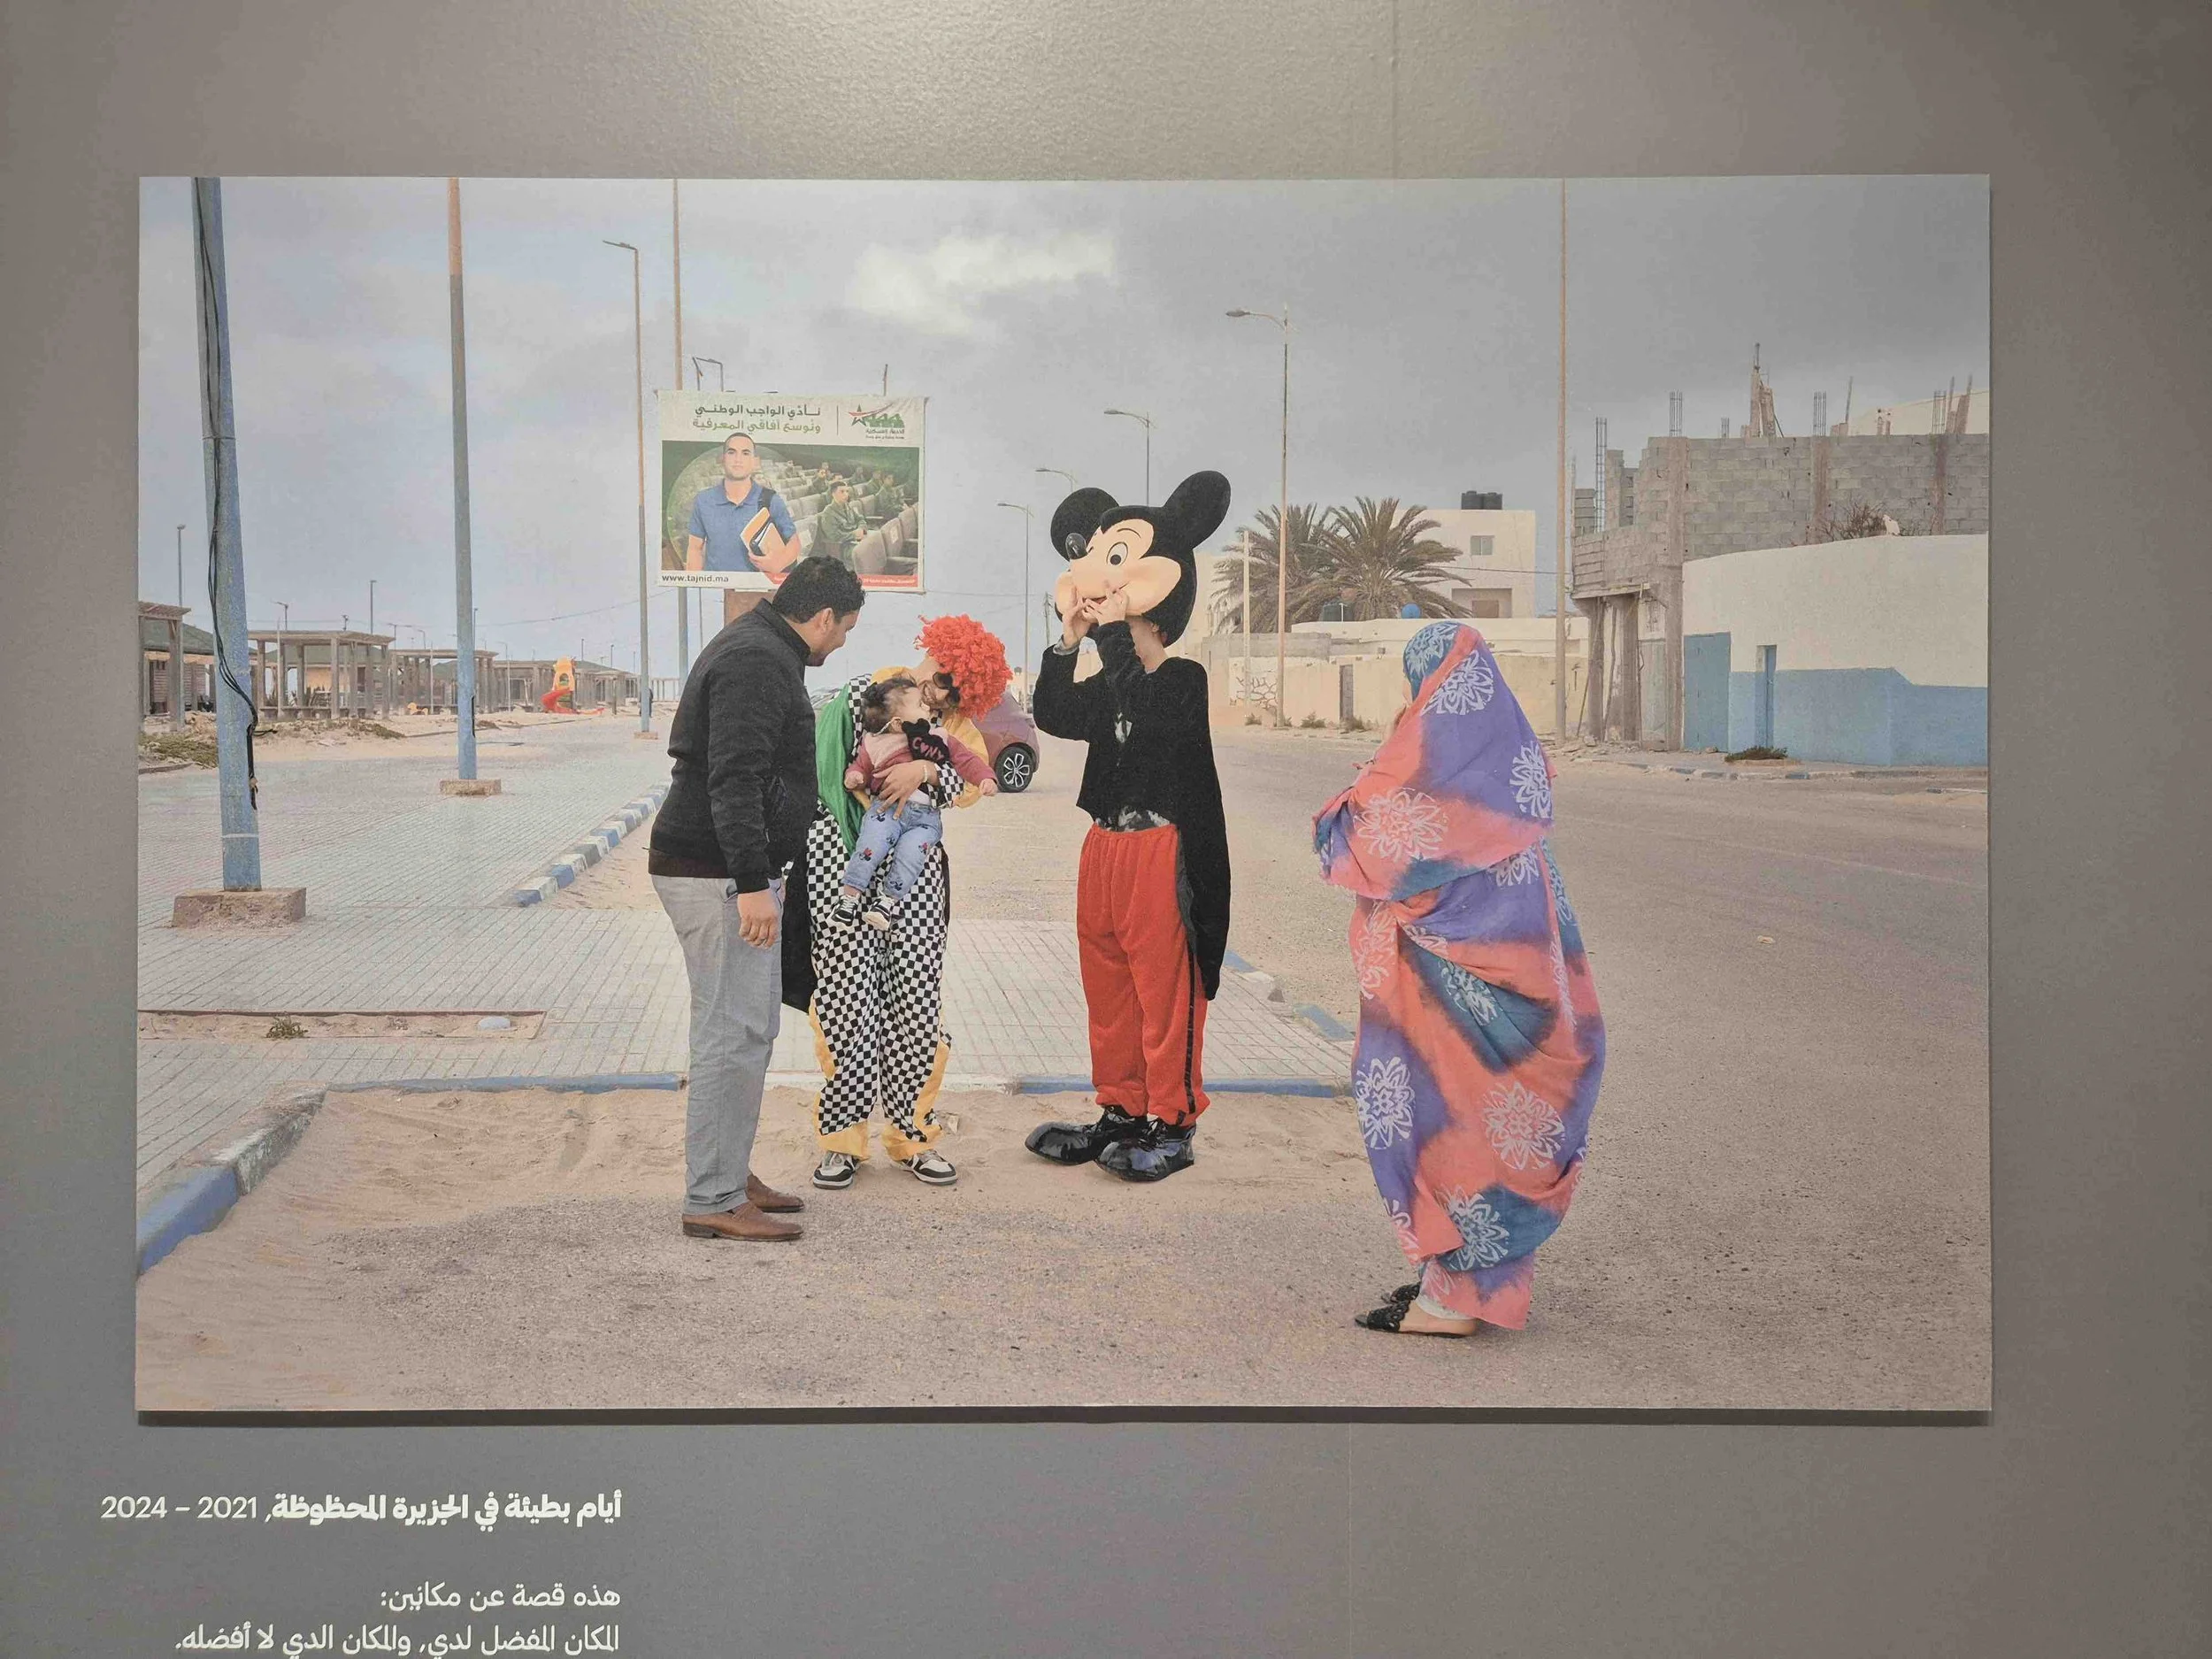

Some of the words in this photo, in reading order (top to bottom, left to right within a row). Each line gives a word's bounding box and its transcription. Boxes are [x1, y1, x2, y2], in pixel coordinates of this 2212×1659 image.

[695, 404, 743, 418] الوطني
[746, 404, 785, 418] الواجب
[692, 418, 744, 431] المعرفية
[661, 574, 729, 583] www.tajnid.ma
[100, 1495, 167, 1518] 2024
[197, 1496, 257, 1518] 2021
[392, 1494, 469, 1526] الجزيرة
[474, 1491, 499, 1532] في
[503, 1492, 571, 1524] بطيئة
[576, 1488, 622, 1527] أيام
[380, 1580, 461, 1611] مكانين:
[469, 1589, 504, 1611] عن
[511, 1582, 565, 1607] قصة
[572, 1584, 620, 1607] هذه
[175, 1620, 251, 1649] أفضله.
[257, 1624, 274, 1650] لا
[342, 1624, 411, 1655] والمكان
[480, 1624, 555, 1655] المفضل
[565, 1624, 619, 1655] المكان
